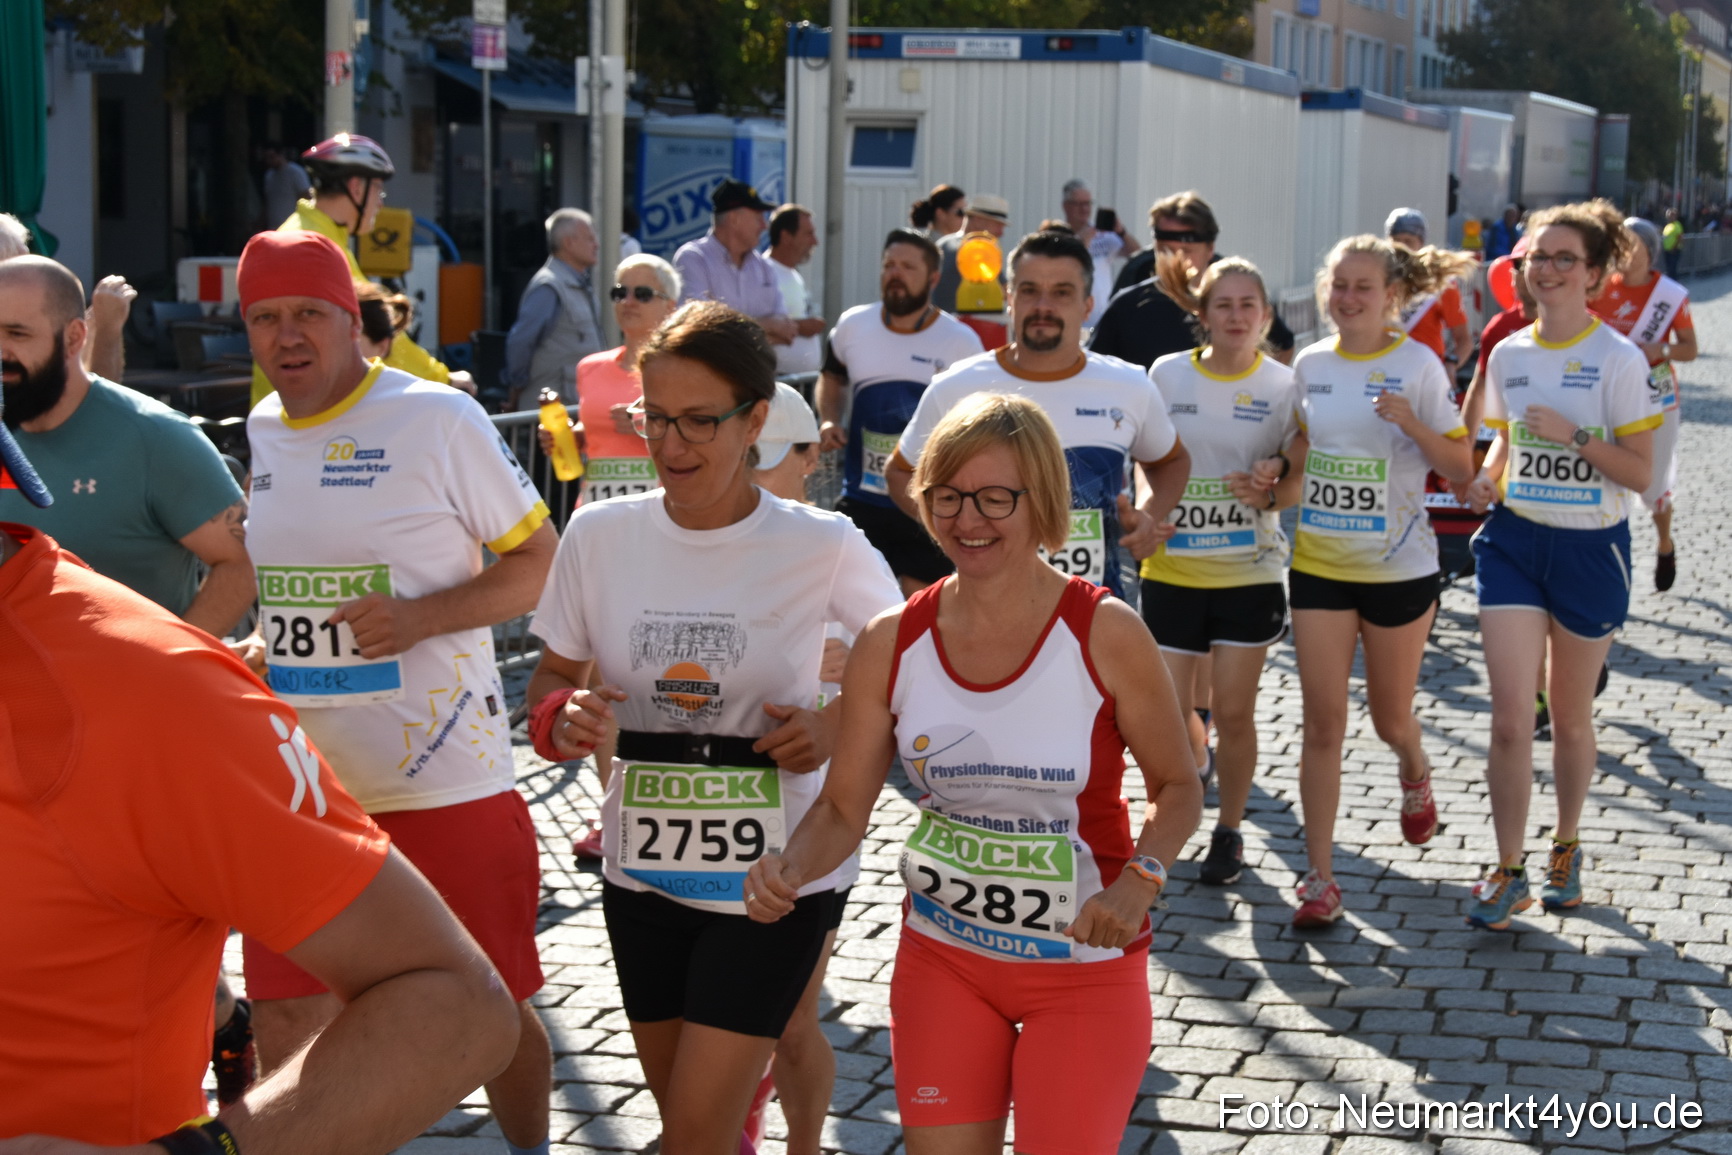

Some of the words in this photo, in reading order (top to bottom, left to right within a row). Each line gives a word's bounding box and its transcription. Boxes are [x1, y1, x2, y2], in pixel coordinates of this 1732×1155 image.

[1642, 301, 1671, 341] auch
[325, 443, 355, 461] 20
[323, 462, 391, 474] Neumarkter
[588, 460, 648, 478] BOCK
[1310, 455, 1380, 479] BOCK
[1519, 452, 1593, 482] 2060
[320, 476, 376, 488] Stadtlauf
[1514, 485, 1594, 500] ALEXANDRA
[1309, 480, 1376, 511] 2039
[1175, 504, 1244, 529] 2044
[1309, 512, 1374, 529] CHRISTIN
[1187, 535, 1231, 548] LINDA
[265, 570, 375, 602] BOCK
[270, 615, 361, 657] 281
[651, 694, 724, 711] Herbstlauf
[427, 710, 460, 753] September
[930, 763, 1037, 780] Physiotherapie
[1041, 768, 1076, 782] Wild
[633, 770, 768, 804] BOCK
[947, 782, 970, 790] Praxis
[984, 782, 1057, 794] Krankengymnastik
[950, 812, 1014, 833] machen
[1018, 818, 1046, 834] Sie
[637, 817, 765, 862] 2759
[920, 820, 1059, 875] BOCK
[918, 865, 1050, 931] 2282
[1059, 895, 1067, 903] D
[934, 911, 1042, 957] CLAUDIA
